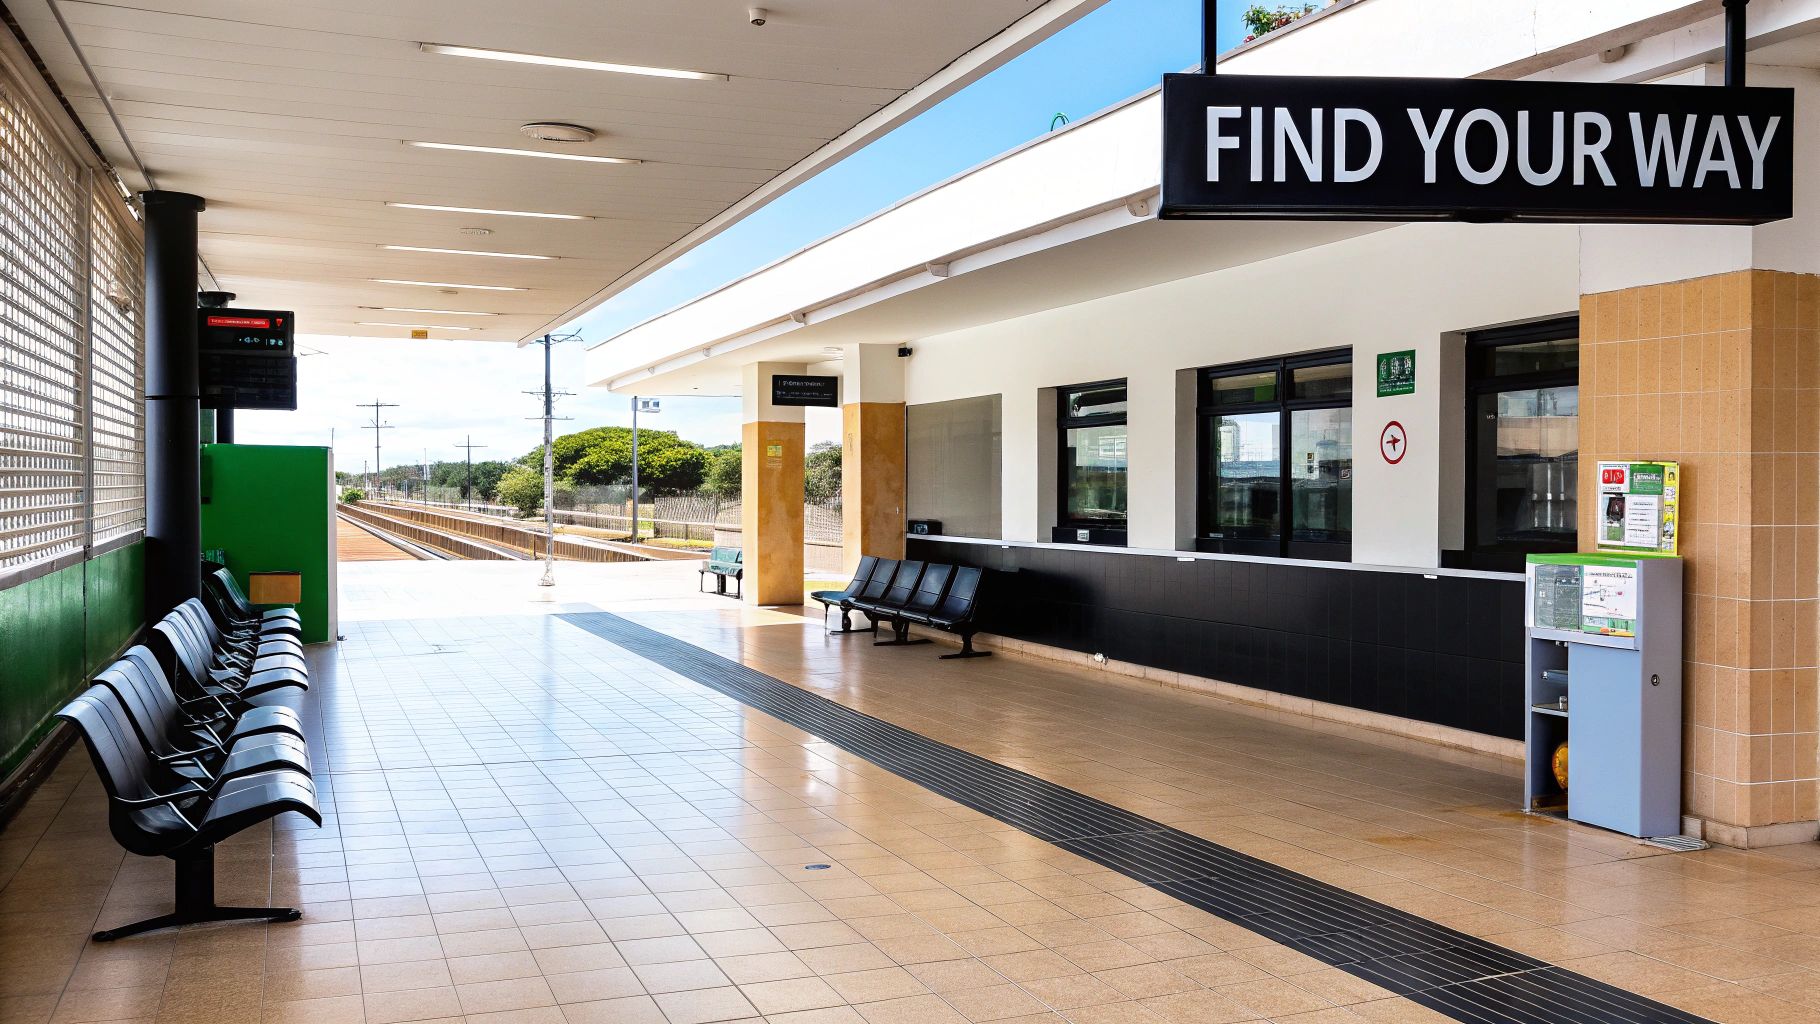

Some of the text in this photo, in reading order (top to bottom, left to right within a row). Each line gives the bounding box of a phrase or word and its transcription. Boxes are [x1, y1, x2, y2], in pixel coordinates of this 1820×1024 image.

[1206, 105, 1781, 190] FIND YOUR WAY
